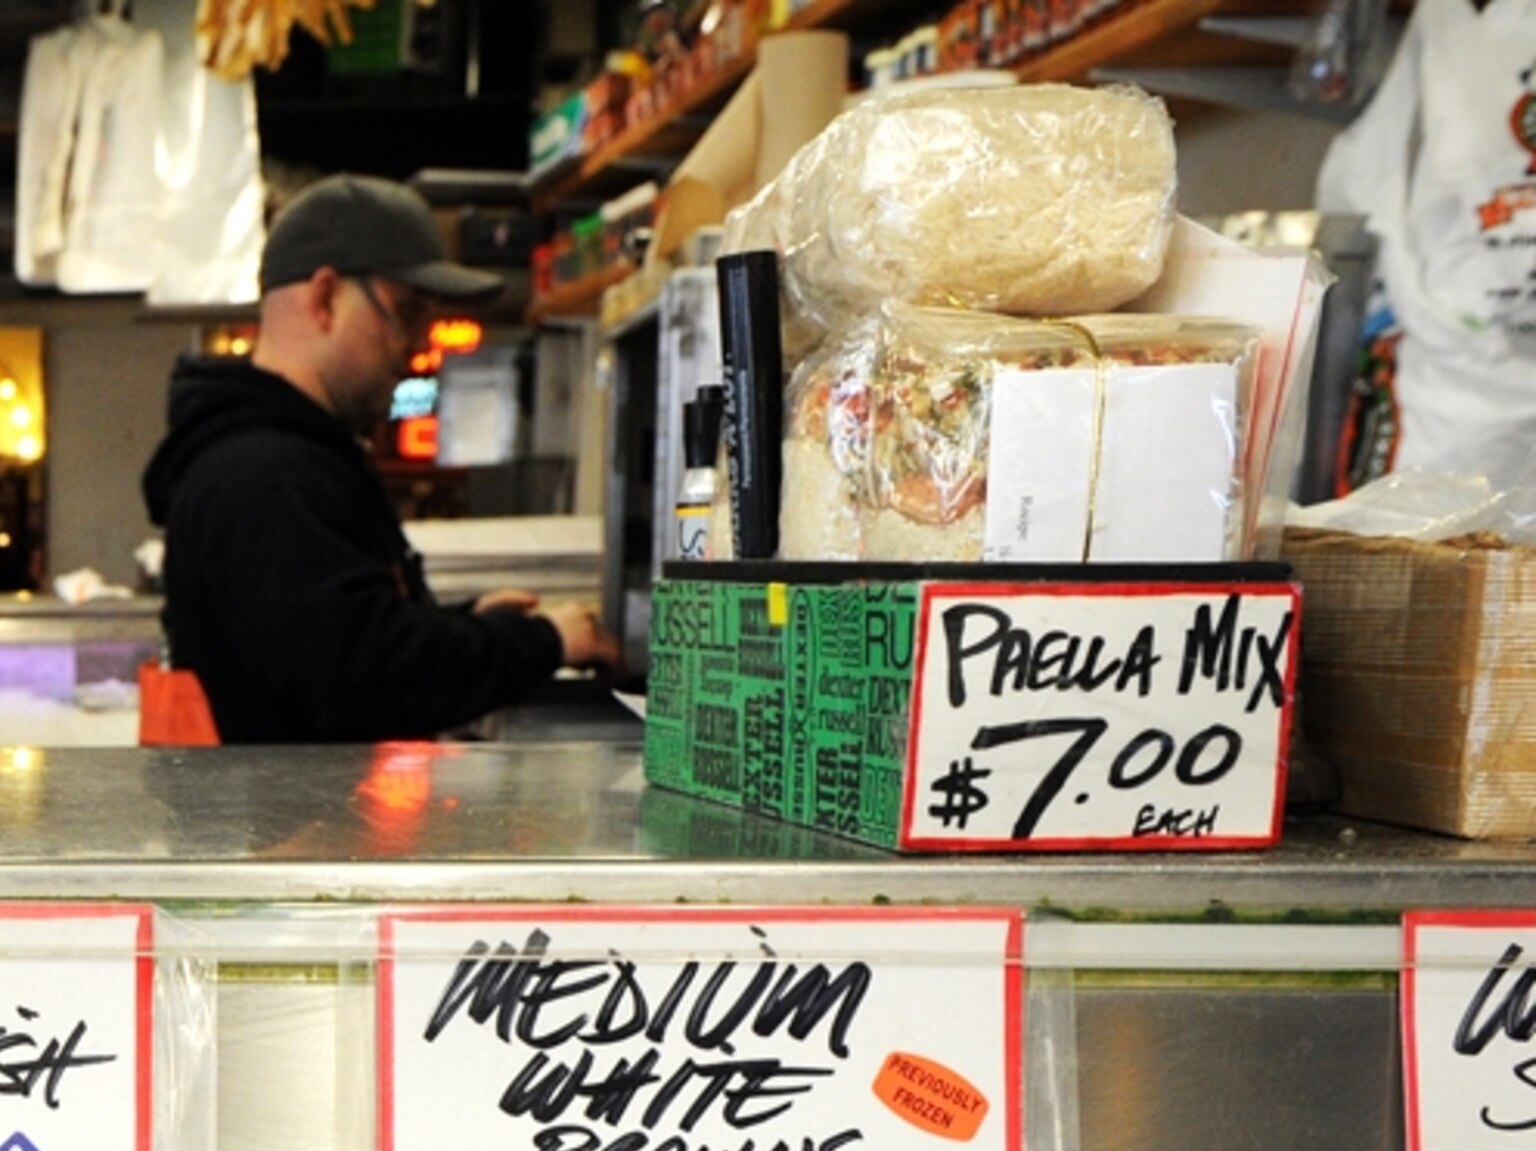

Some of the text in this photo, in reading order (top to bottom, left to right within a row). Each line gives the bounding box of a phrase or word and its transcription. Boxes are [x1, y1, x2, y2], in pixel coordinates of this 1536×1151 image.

[943, 592, 1296, 713] PAELLA MIX
[1132, 804, 1219, 838] EACH
[424, 926, 872, 1059] MEDIUM
[499, 1048, 835, 1133] WHITE
[888, 1055, 982, 1113] PREVIOUSLY
[893, 1086, 953, 1129] FROZEN
